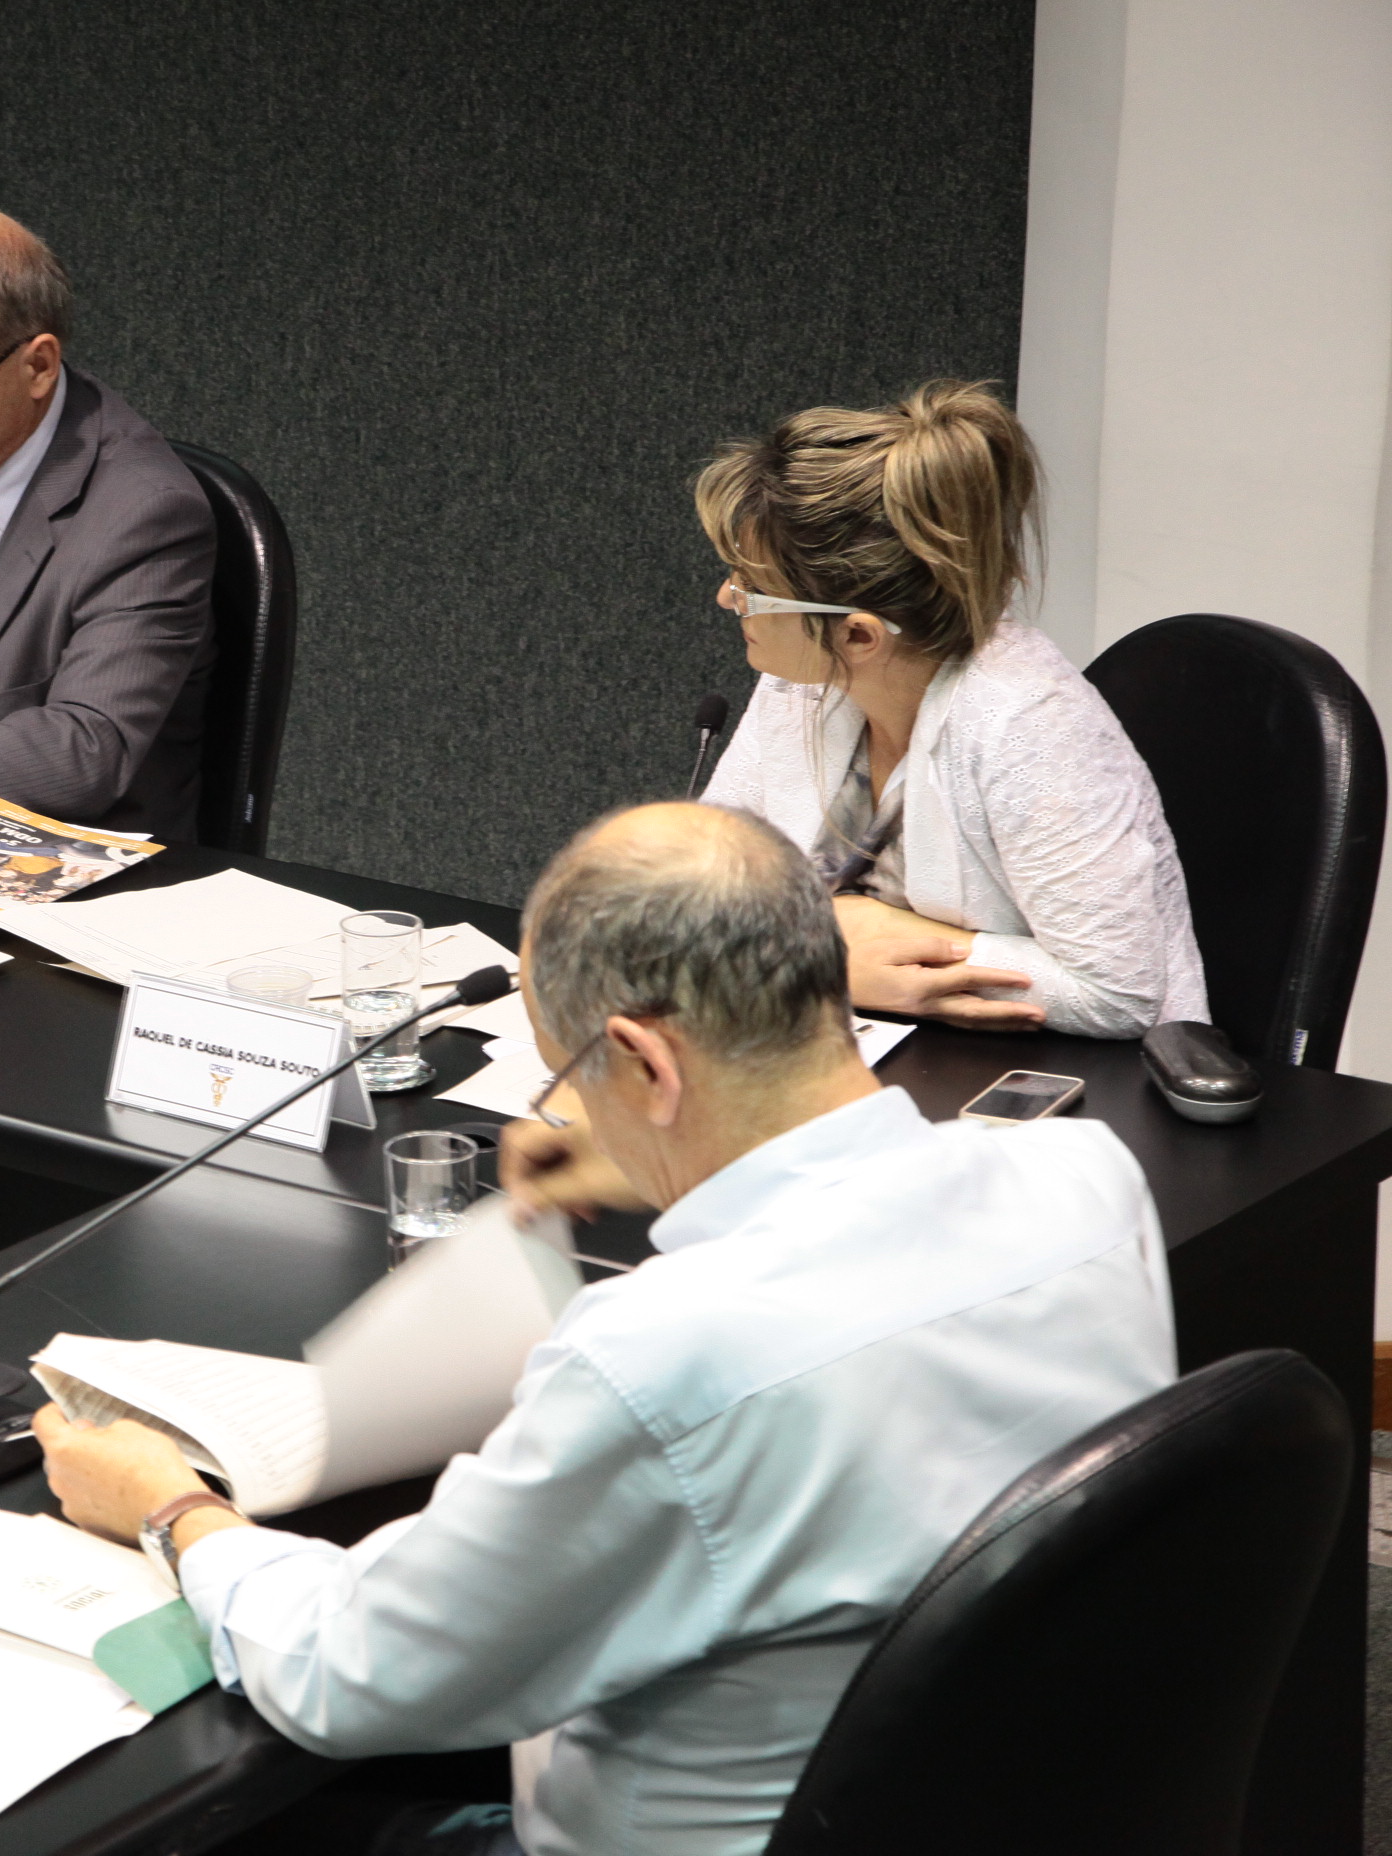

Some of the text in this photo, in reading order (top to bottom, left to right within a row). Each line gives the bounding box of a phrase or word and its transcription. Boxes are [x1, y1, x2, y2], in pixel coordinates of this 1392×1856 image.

[133, 1027, 319, 1078] RAQUEL DE CASSIA SOUZA SOUTO
